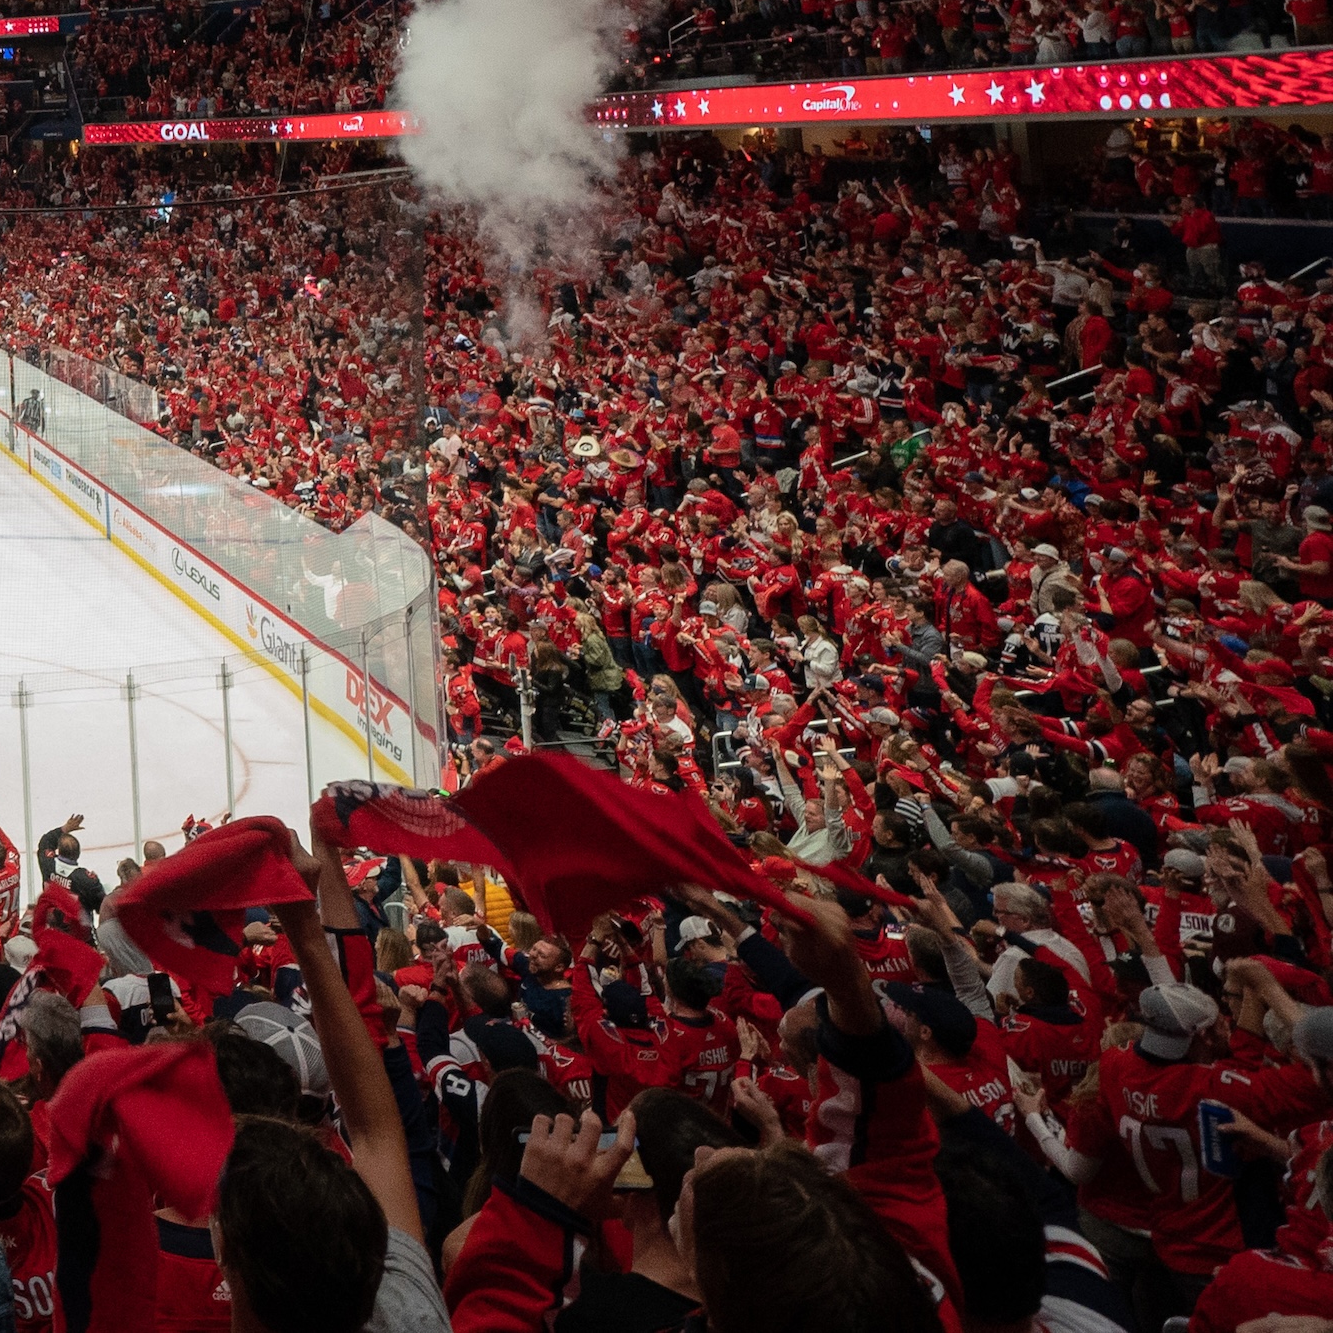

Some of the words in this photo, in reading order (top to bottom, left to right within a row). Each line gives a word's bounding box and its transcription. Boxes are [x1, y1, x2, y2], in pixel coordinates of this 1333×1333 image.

[161, 123, 209, 141] GOAL
[184, 561, 220, 601] LEXUS
[260, 617, 297, 674] Giant
[50, 873, 73, 890] OSHIE
[699, 1045, 729, 1066] OSHIE
[1119, 1115, 1201, 1203] 77
